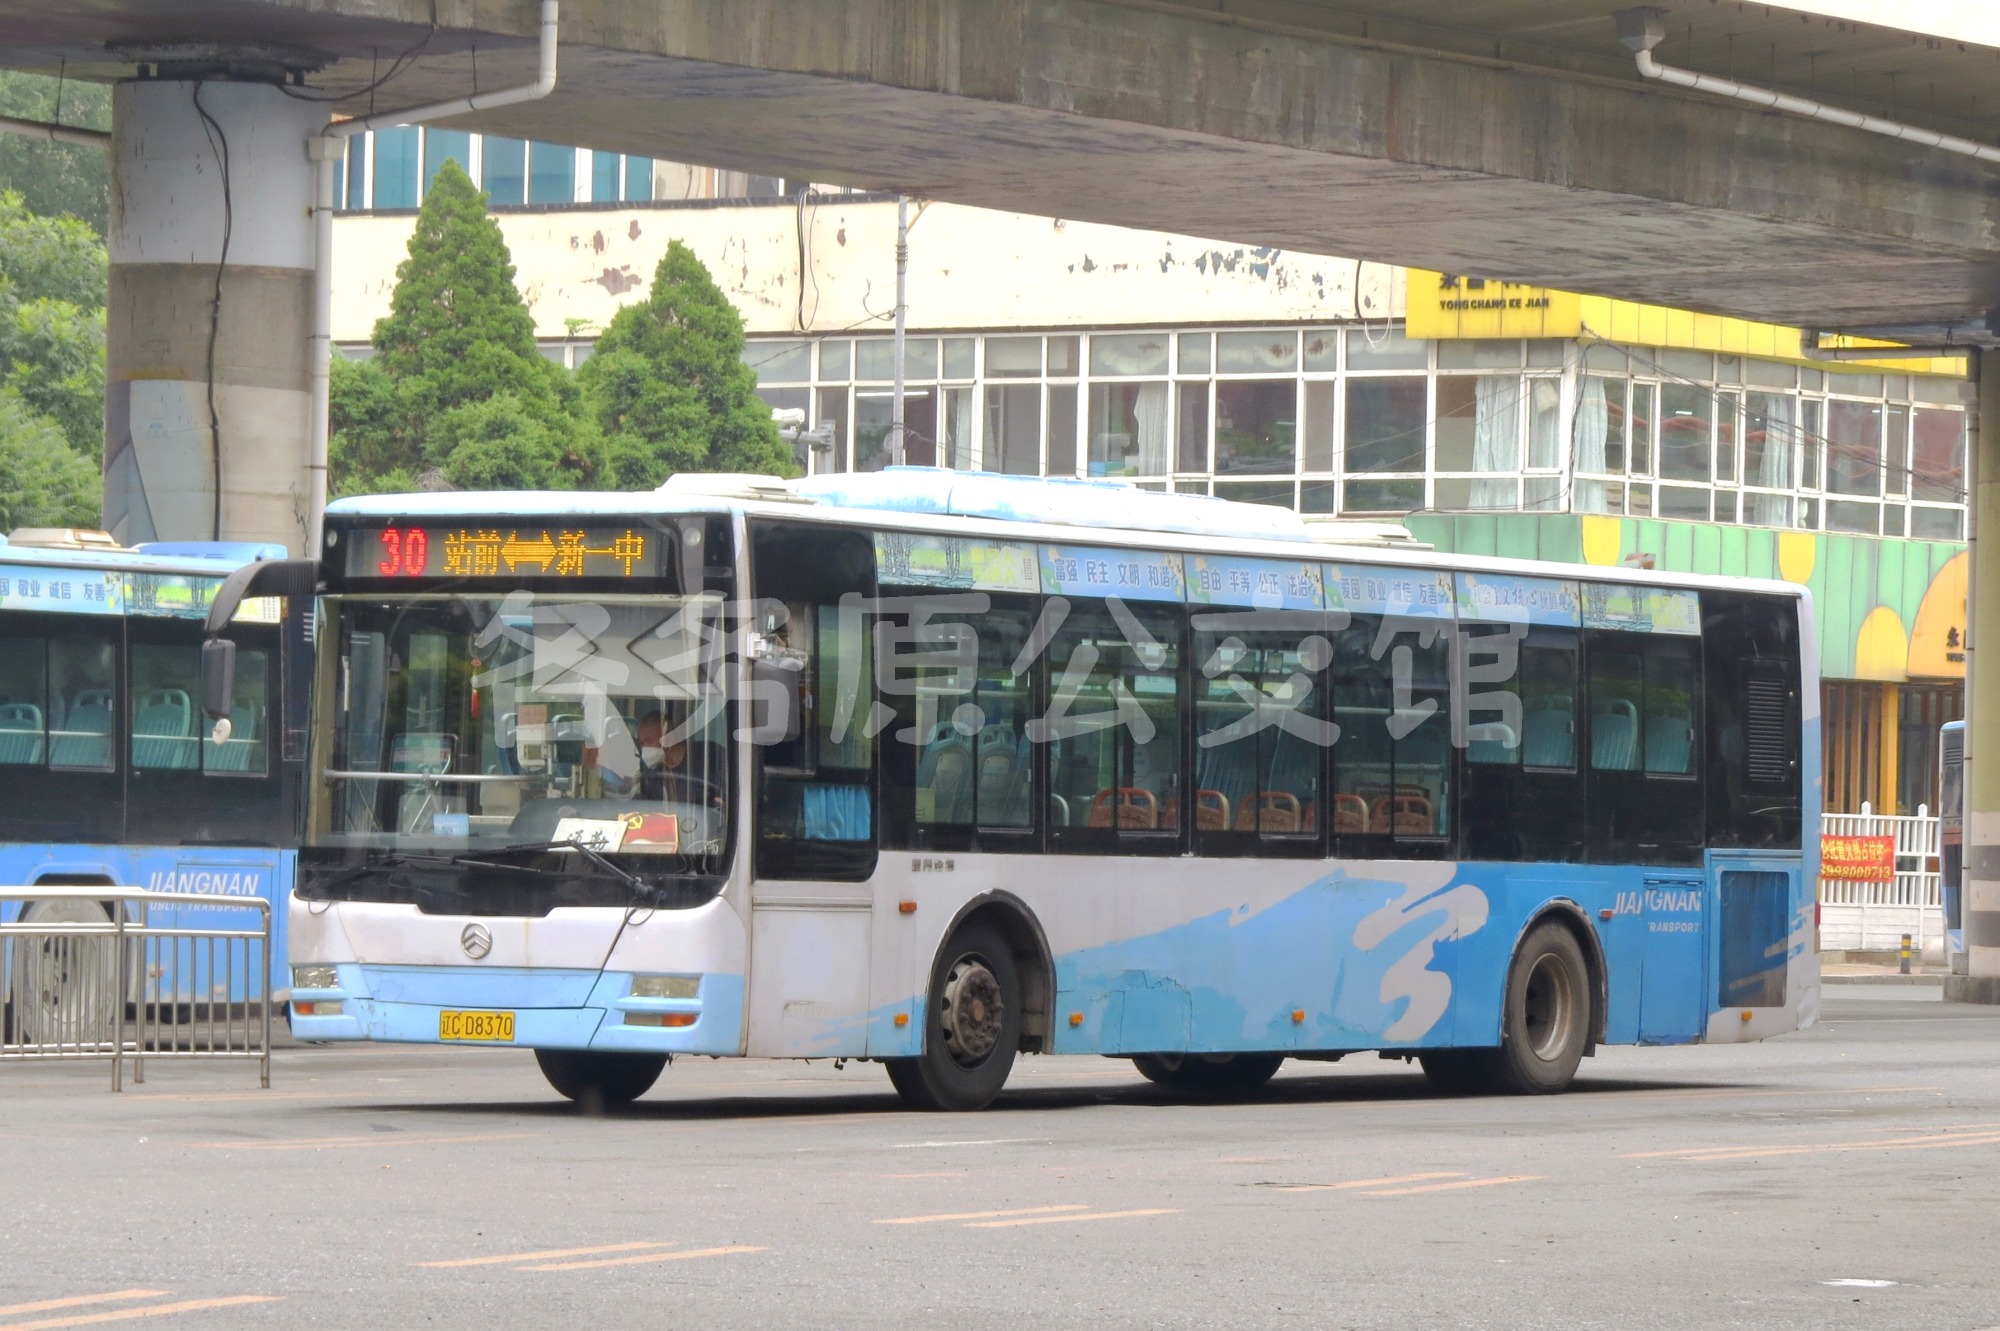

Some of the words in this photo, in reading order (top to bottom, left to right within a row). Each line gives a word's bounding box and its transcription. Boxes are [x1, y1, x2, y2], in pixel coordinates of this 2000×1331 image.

[1440, 300, 1469, 310] YONG
[1470, 299, 1506, 309] CHANG
[1509, 298, 1521, 308] KE
[1525, 297, 1549, 308] JIAN
[379, 528, 428, 576] 30
[1055, 559, 1079, 582] 富强
[1086, 561, 1110, 584] 民主
[1117, 562, 1140, 586] 文明
[1147, 565, 1170, 588] 和谐
[1200, 568, 1221, 591] 自由
[1229, 570, 1251, 593] 平等
[1259, 572, 1280, 595] 公正
[1287, 573, 1308, 596] 法治
[18, 579, 41, 598] 敬业
[49, 581, 71, 600] 诚信
[83, 582, 105, 602] 友善
[1341, 578, 1361, 600] 爱国
[1367, 579, 1387, 601] 敬业
[1419, 583, 1438, 605] 友善
[145, 871, 259, 896] JIANGNAN
[1648, 922, 1699, 933] RANSPORT
